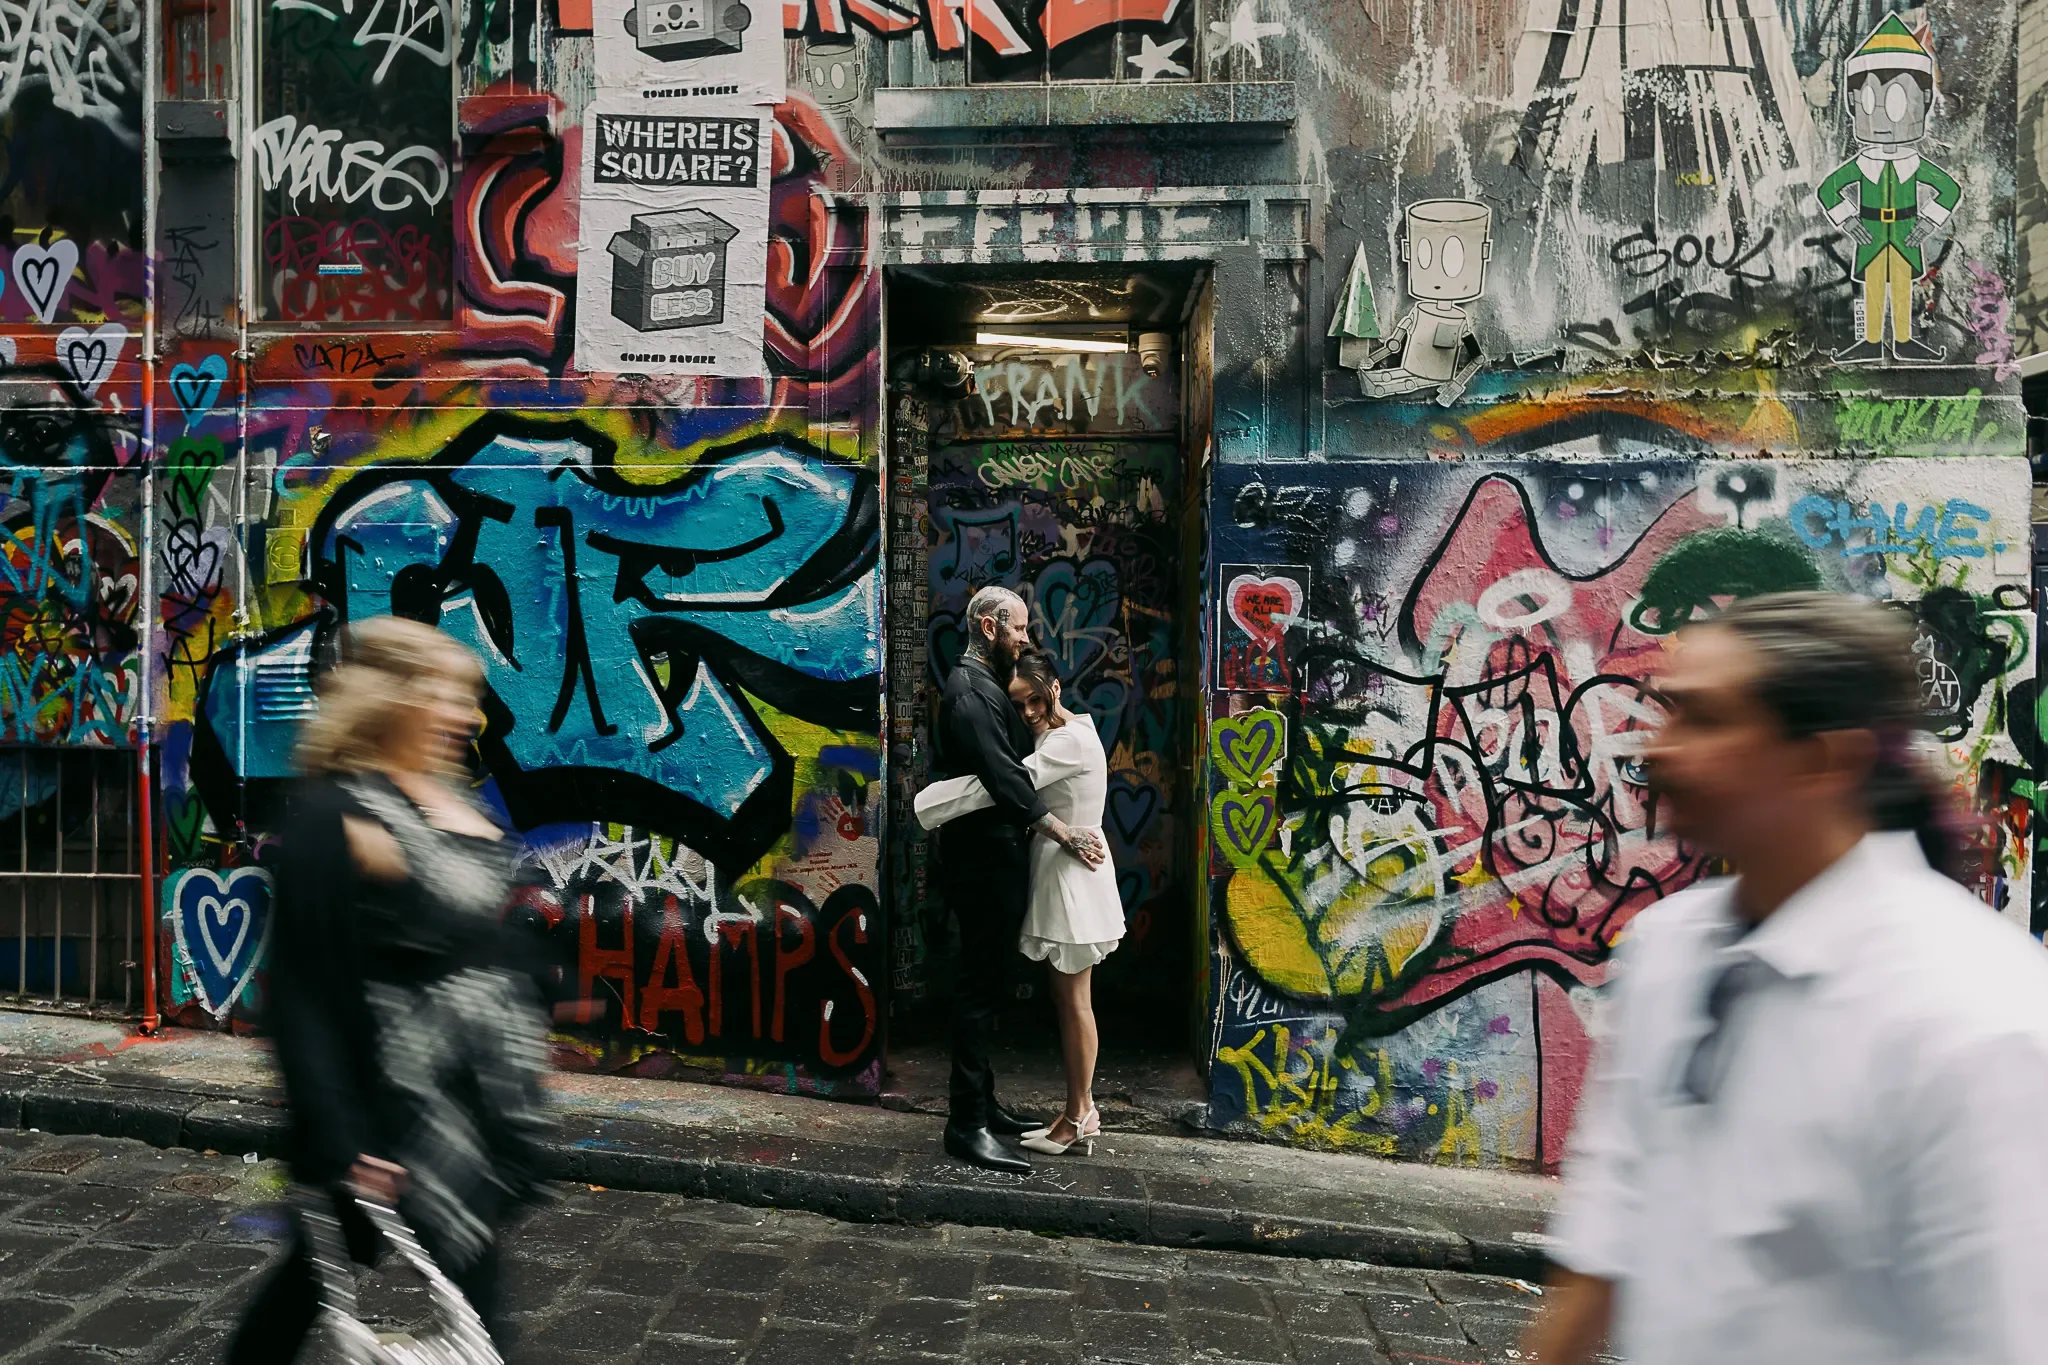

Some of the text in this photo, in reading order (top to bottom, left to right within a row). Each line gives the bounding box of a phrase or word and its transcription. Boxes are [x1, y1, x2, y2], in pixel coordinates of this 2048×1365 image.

[642, 86, 739, 98] CONRAD SQUARE
[600, 151, 752, 181] SQUARE?
[652, 252, 716, 289] BUY
[650, 288, 714, 321] LESS
[620, 353, 716, 364] CONRAD SQUARE
[975, 359, 1160, 428] FRANK
[1244, 594, 1284, 606] WE ARE
